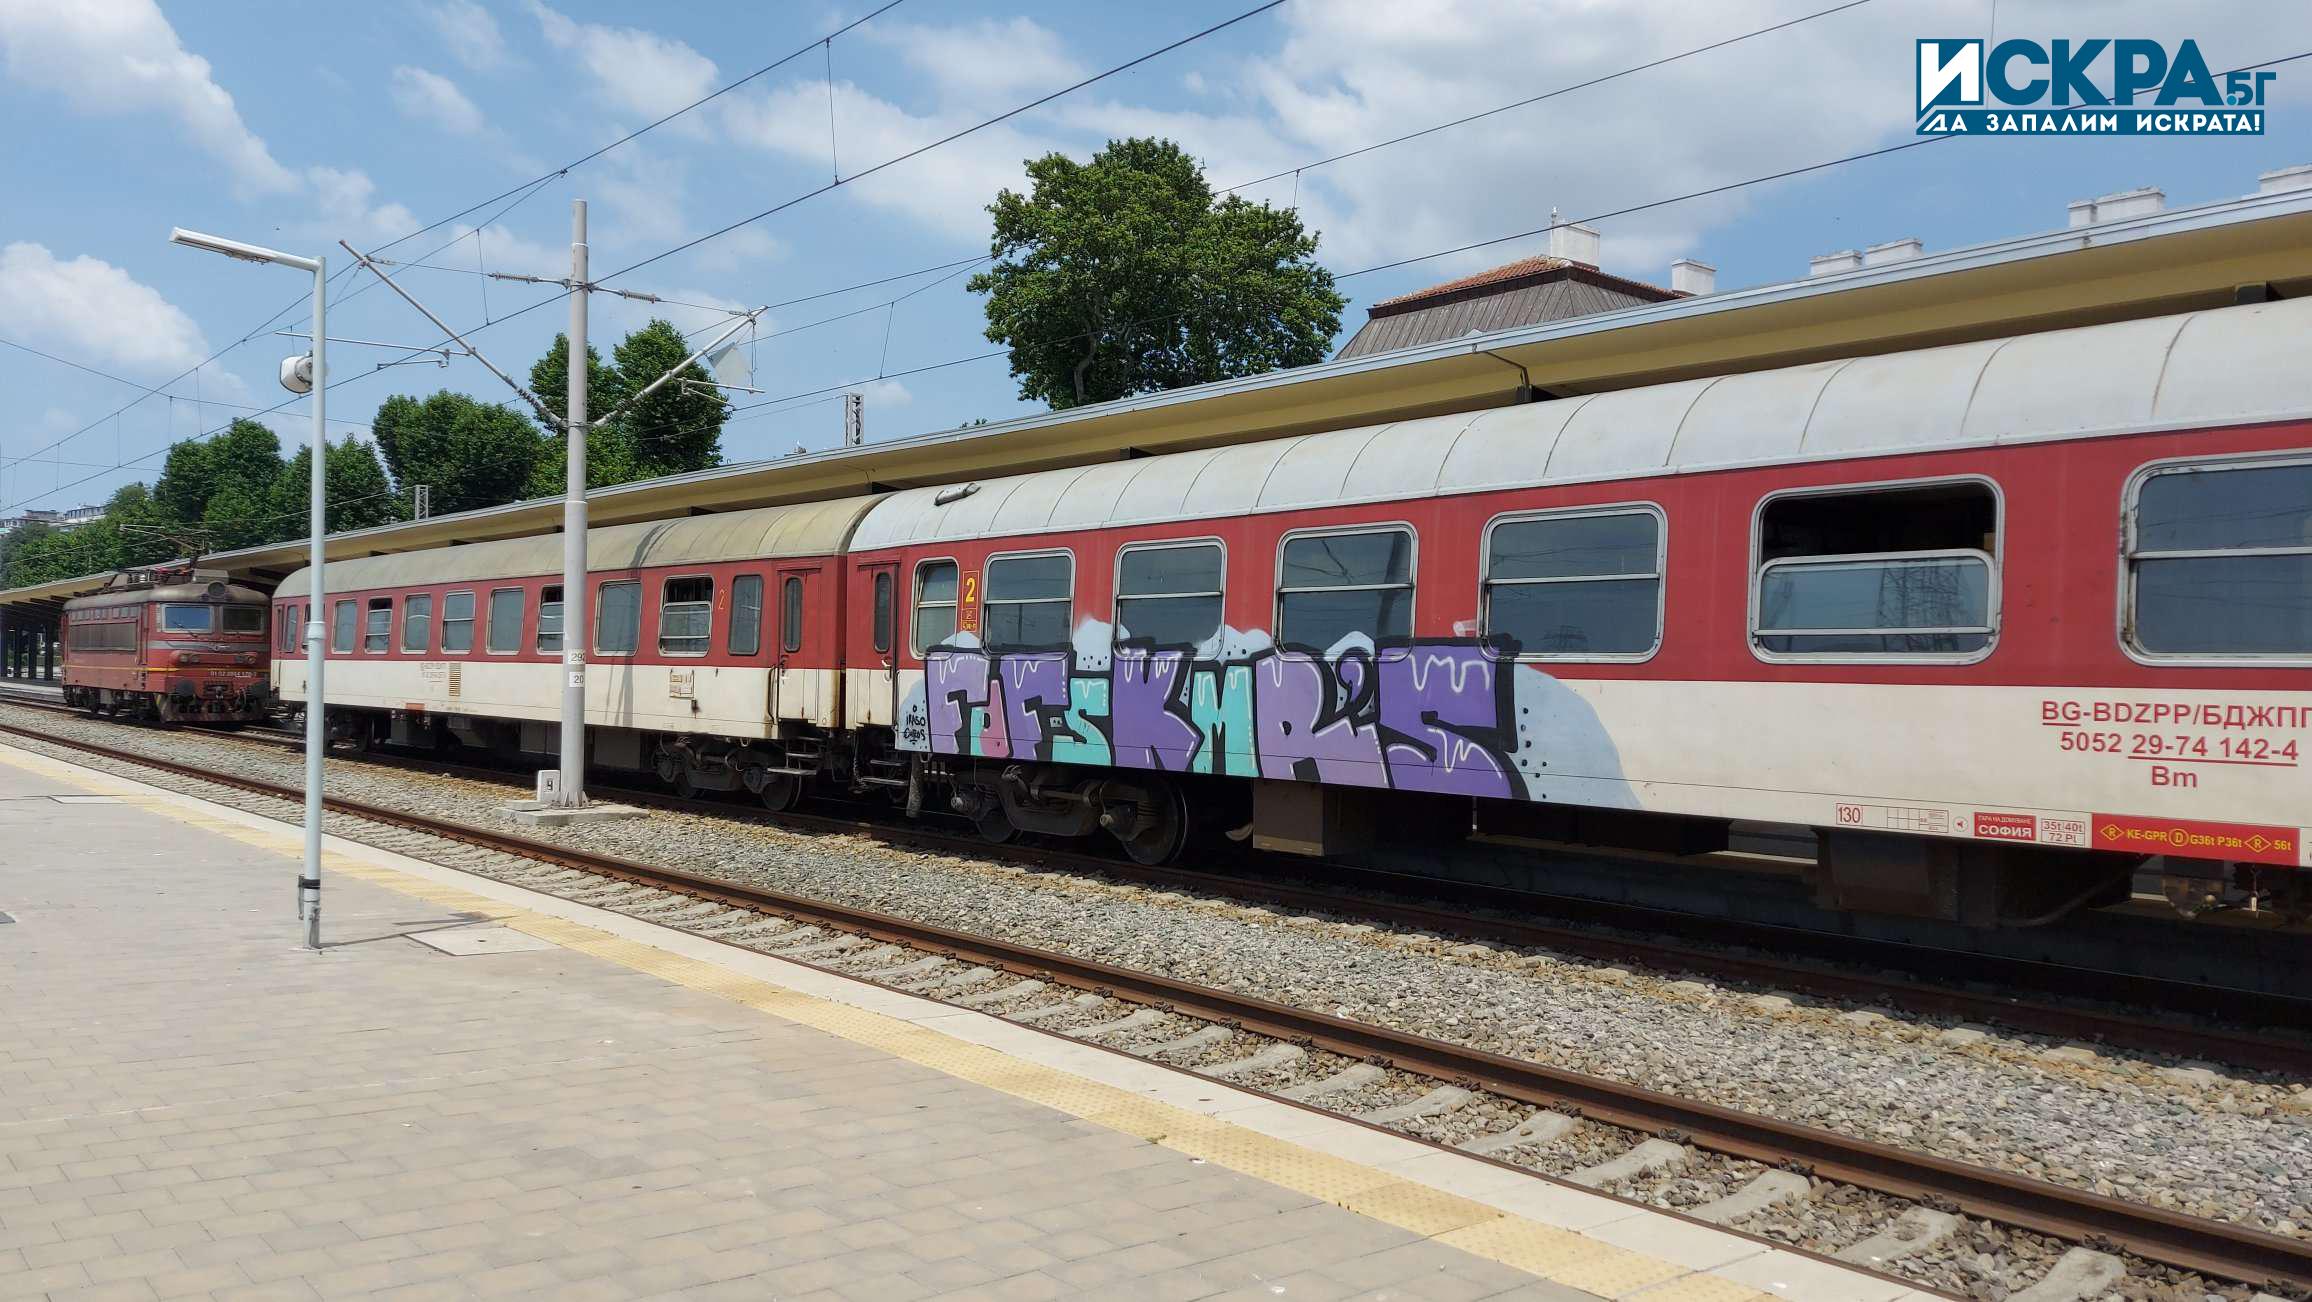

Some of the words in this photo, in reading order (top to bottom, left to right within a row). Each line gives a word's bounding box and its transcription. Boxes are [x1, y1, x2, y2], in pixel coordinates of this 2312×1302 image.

[965, 577, 977, 603] 2
[2060, 731, 2122, 753] 5052
[2132, 733, 2209, 757] 29-74
[2218, 737, 2300, 760] 142-4
[2151, 765, 2198, 788] Bm
[1837, 806, 1861, 824] 130
[2043, 820, 2062, 831] 35t
[1978, 825, 2033, 839] СОФИЯ
[2127, 828, 2168, 842] KE-GPR
[2274, 840, 2291, 851] 56t
